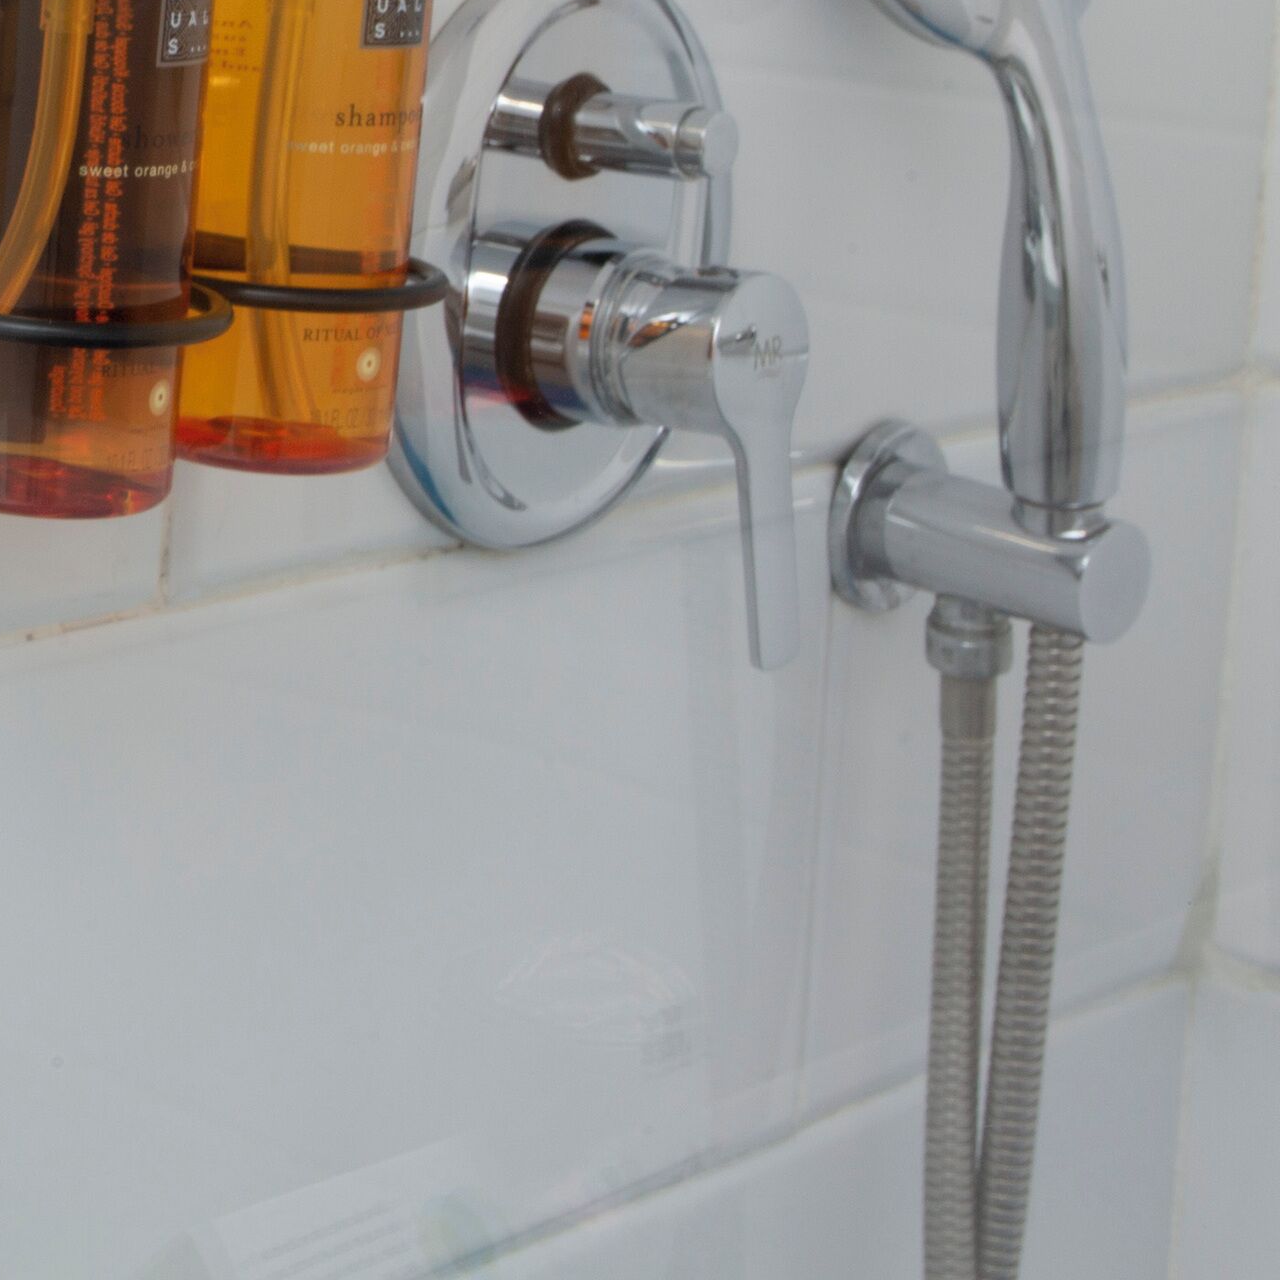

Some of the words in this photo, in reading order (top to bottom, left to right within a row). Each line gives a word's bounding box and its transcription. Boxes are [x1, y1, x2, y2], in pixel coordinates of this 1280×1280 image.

[79, 164, 128, 178] sweet
[134, 163, 178, 179] orange
[303, 328, 360, 342] RITUAL
